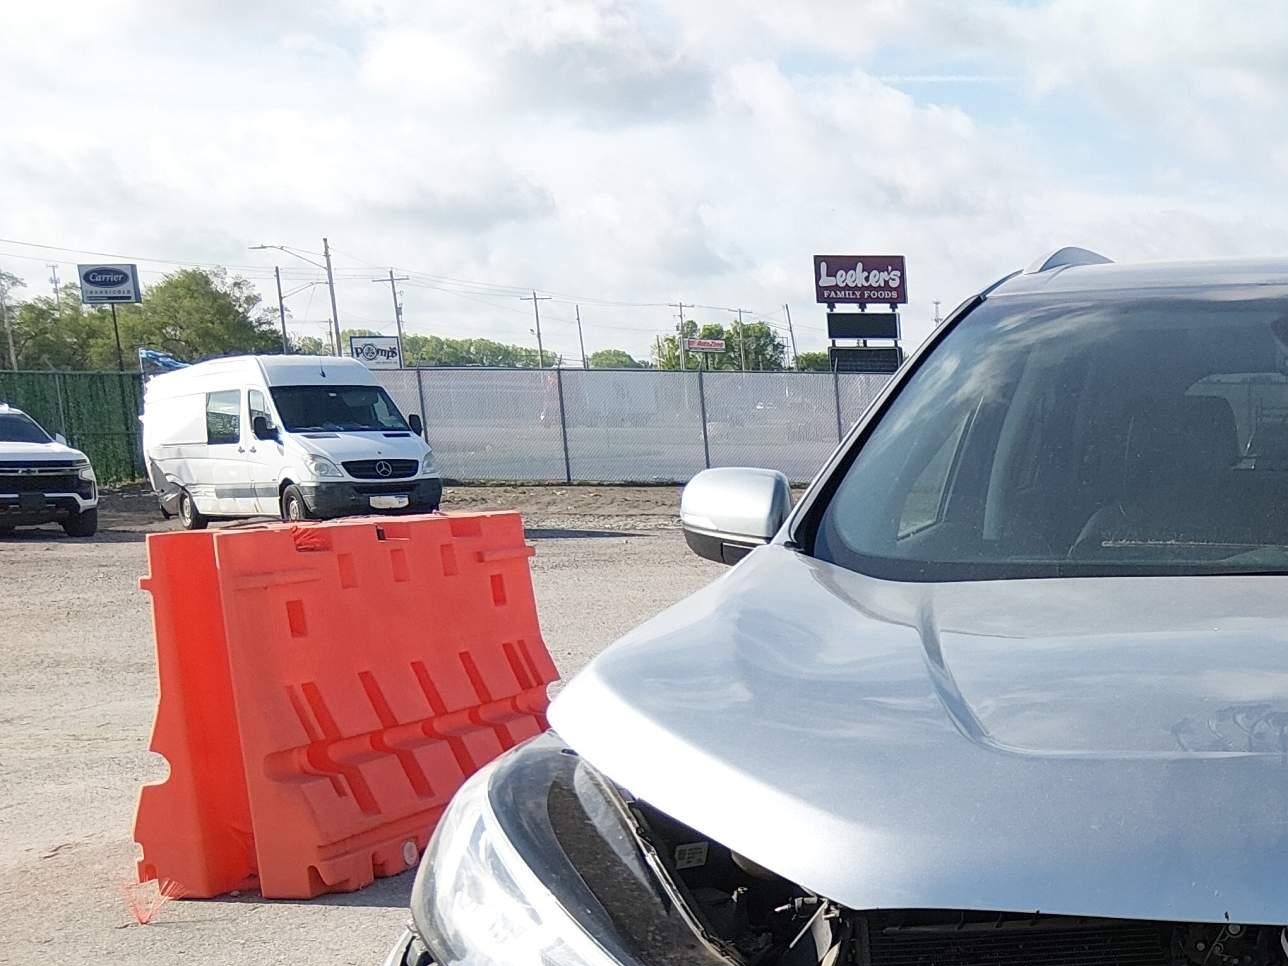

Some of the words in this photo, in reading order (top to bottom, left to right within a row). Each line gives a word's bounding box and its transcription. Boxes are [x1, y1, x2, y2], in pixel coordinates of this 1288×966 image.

[88, 272, 125, 282] Carrier
[819, 261, 901, 288] Leeker's
[823, 290, 861, 298] FAMILY
[864, 290, 898, 299] FOODS
